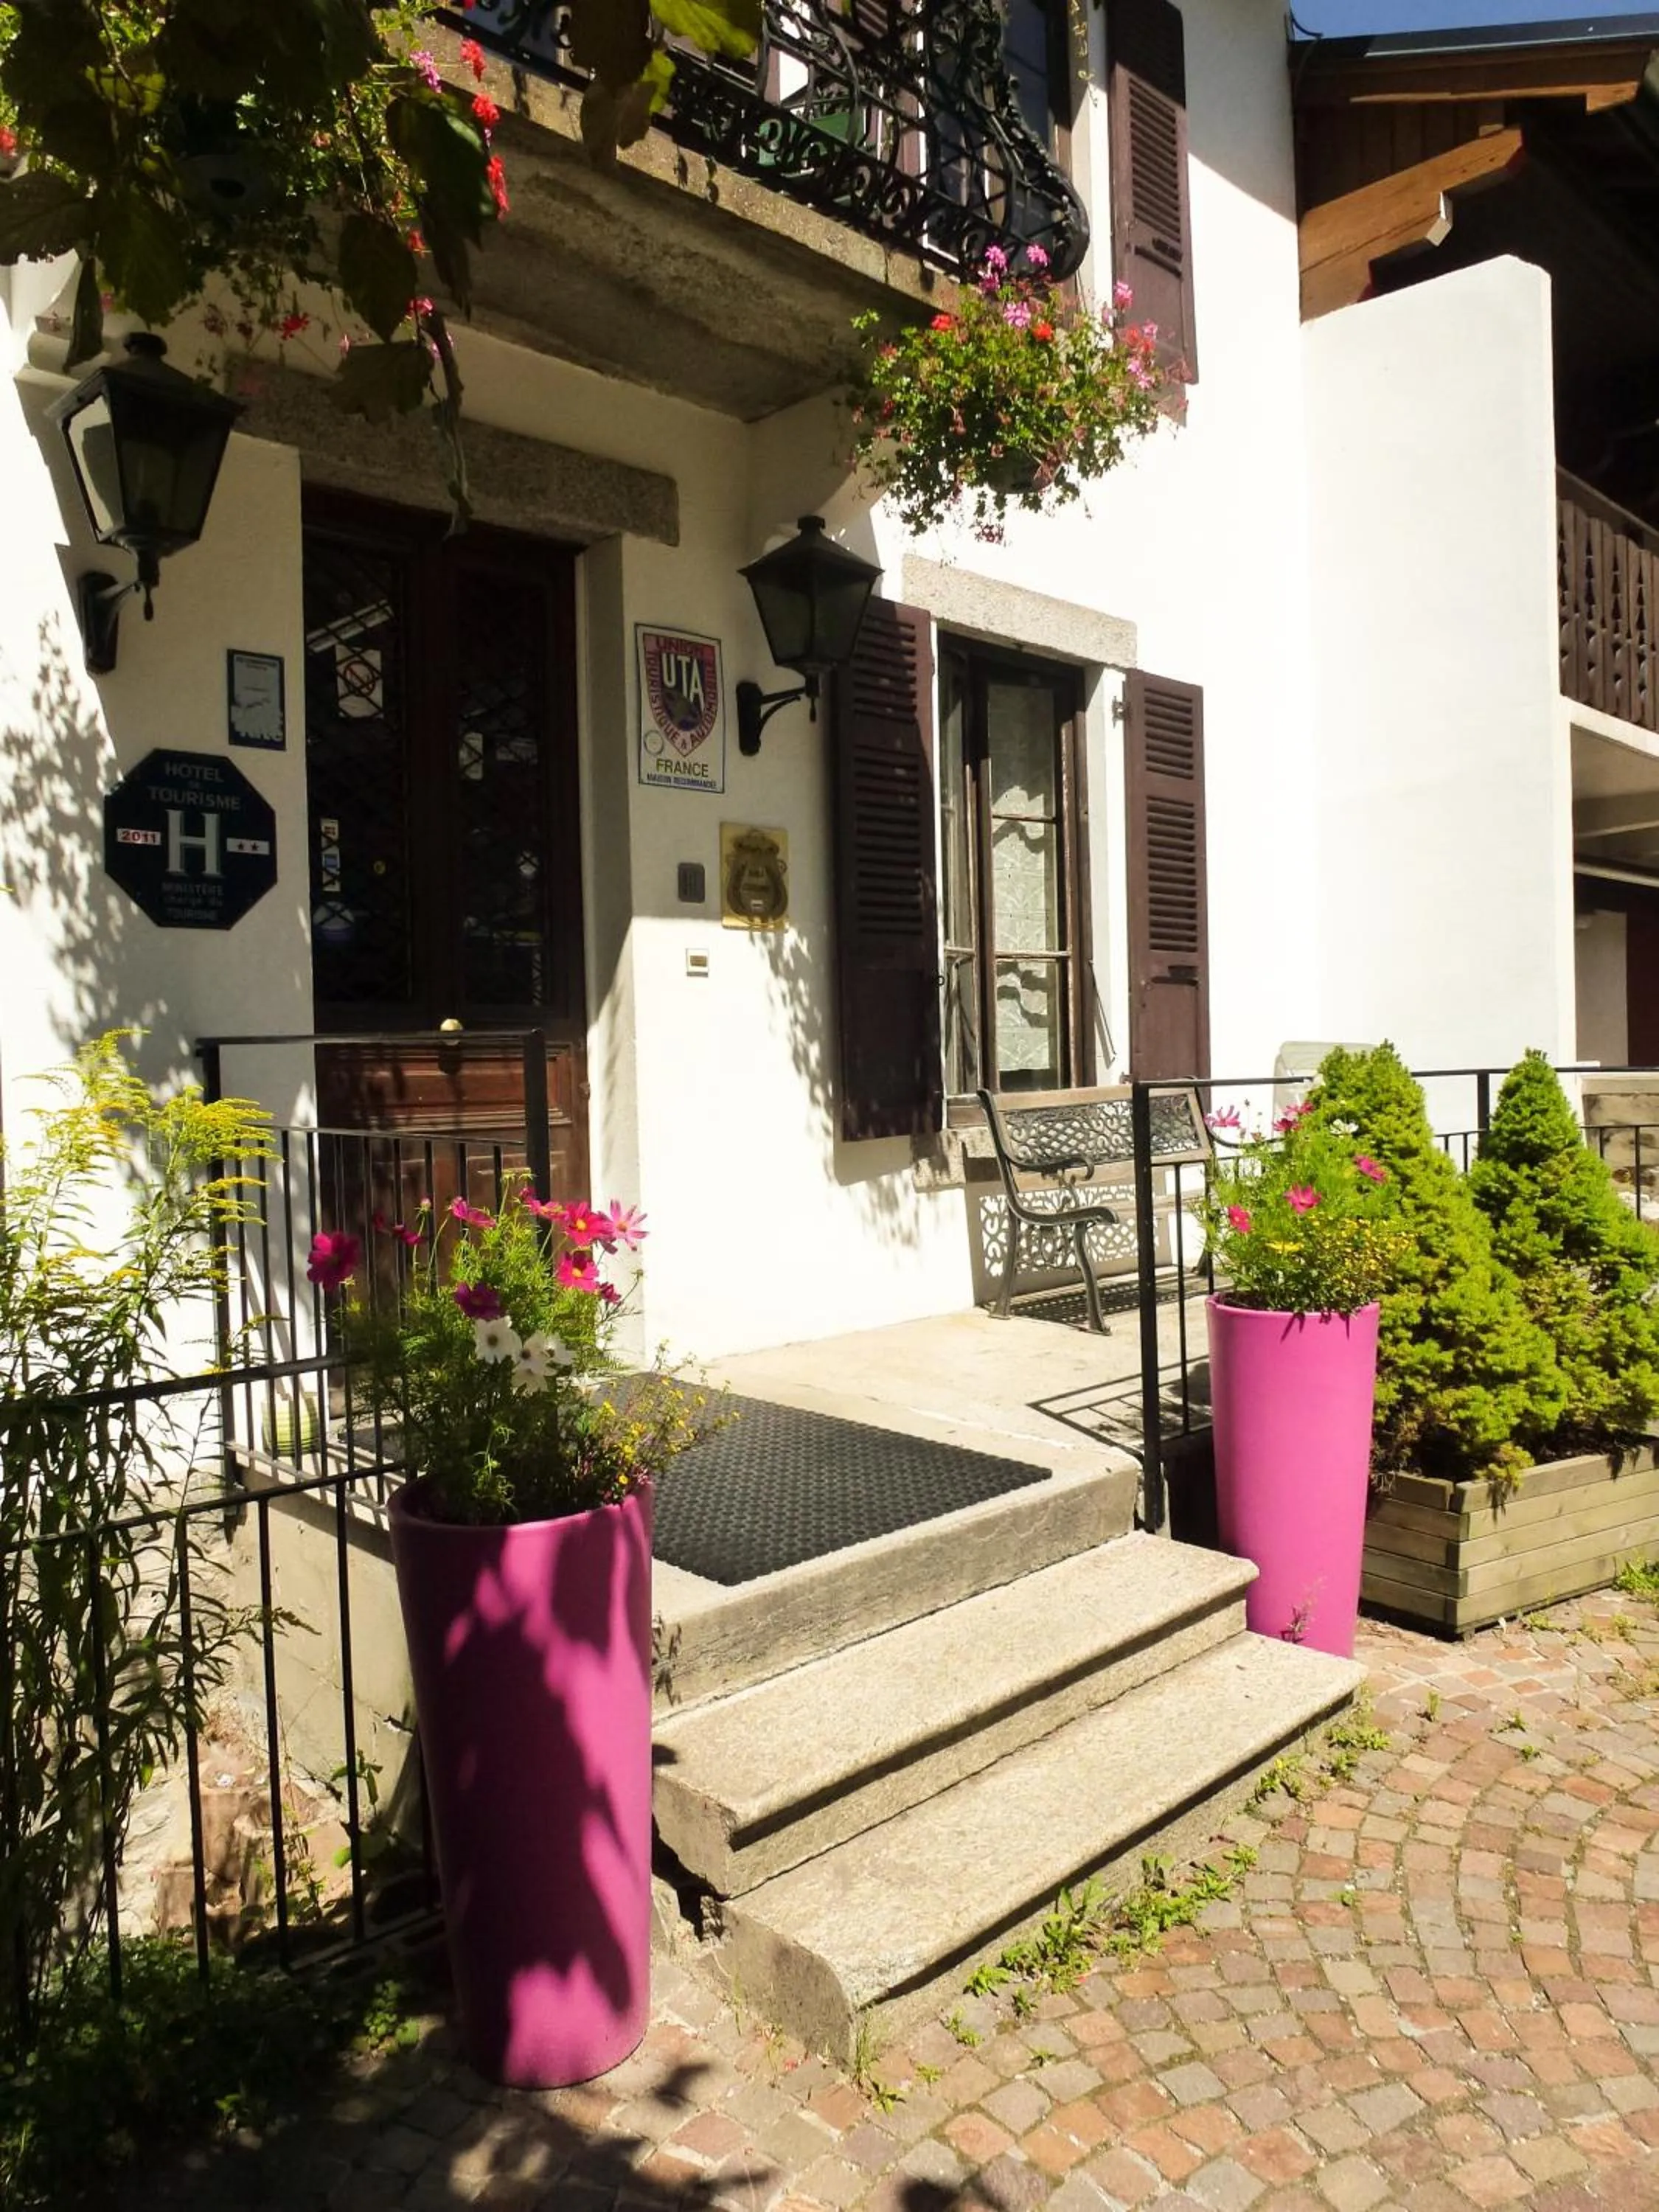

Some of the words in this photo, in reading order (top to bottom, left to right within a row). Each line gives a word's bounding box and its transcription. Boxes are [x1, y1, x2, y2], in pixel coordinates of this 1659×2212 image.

[661, 652, 705, 713] UTA
[164, 761, 224, 782] HOTEL
[656, 758, 709, 777] FRANCE
[148, 786, 242, 811] TOURISME
[122, 830, 156, 844] 2011
[166, 810, 224, 877] H
